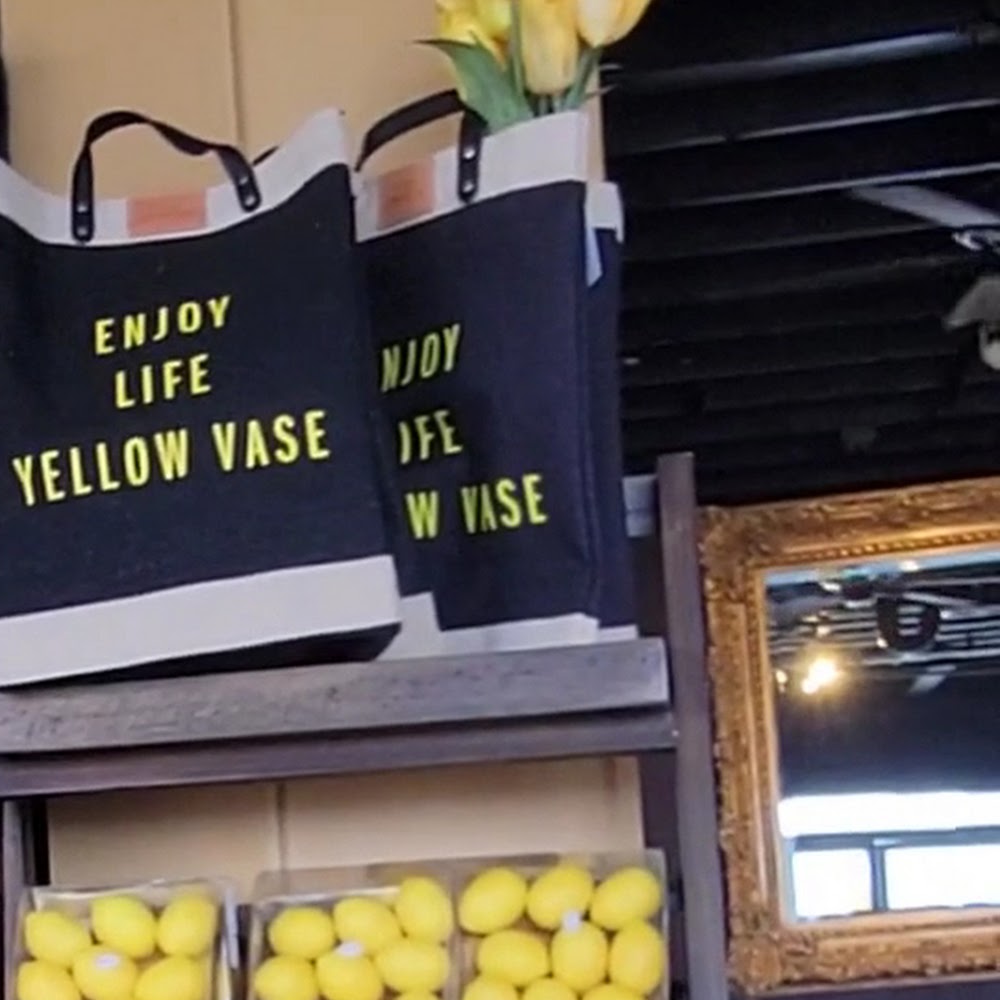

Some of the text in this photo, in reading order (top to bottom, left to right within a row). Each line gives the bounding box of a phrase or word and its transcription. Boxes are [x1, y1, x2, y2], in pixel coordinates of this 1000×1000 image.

[93, 295, 232, 355] ENJOY
[113, 352, 211, 409] LIFE
[381, 323, 461, 392] NJOY
[12, 408, 330, 505] YELLOW VASE
[398, 409, 463, 464] IFE
[405, 472, 548, 539] W VASE
